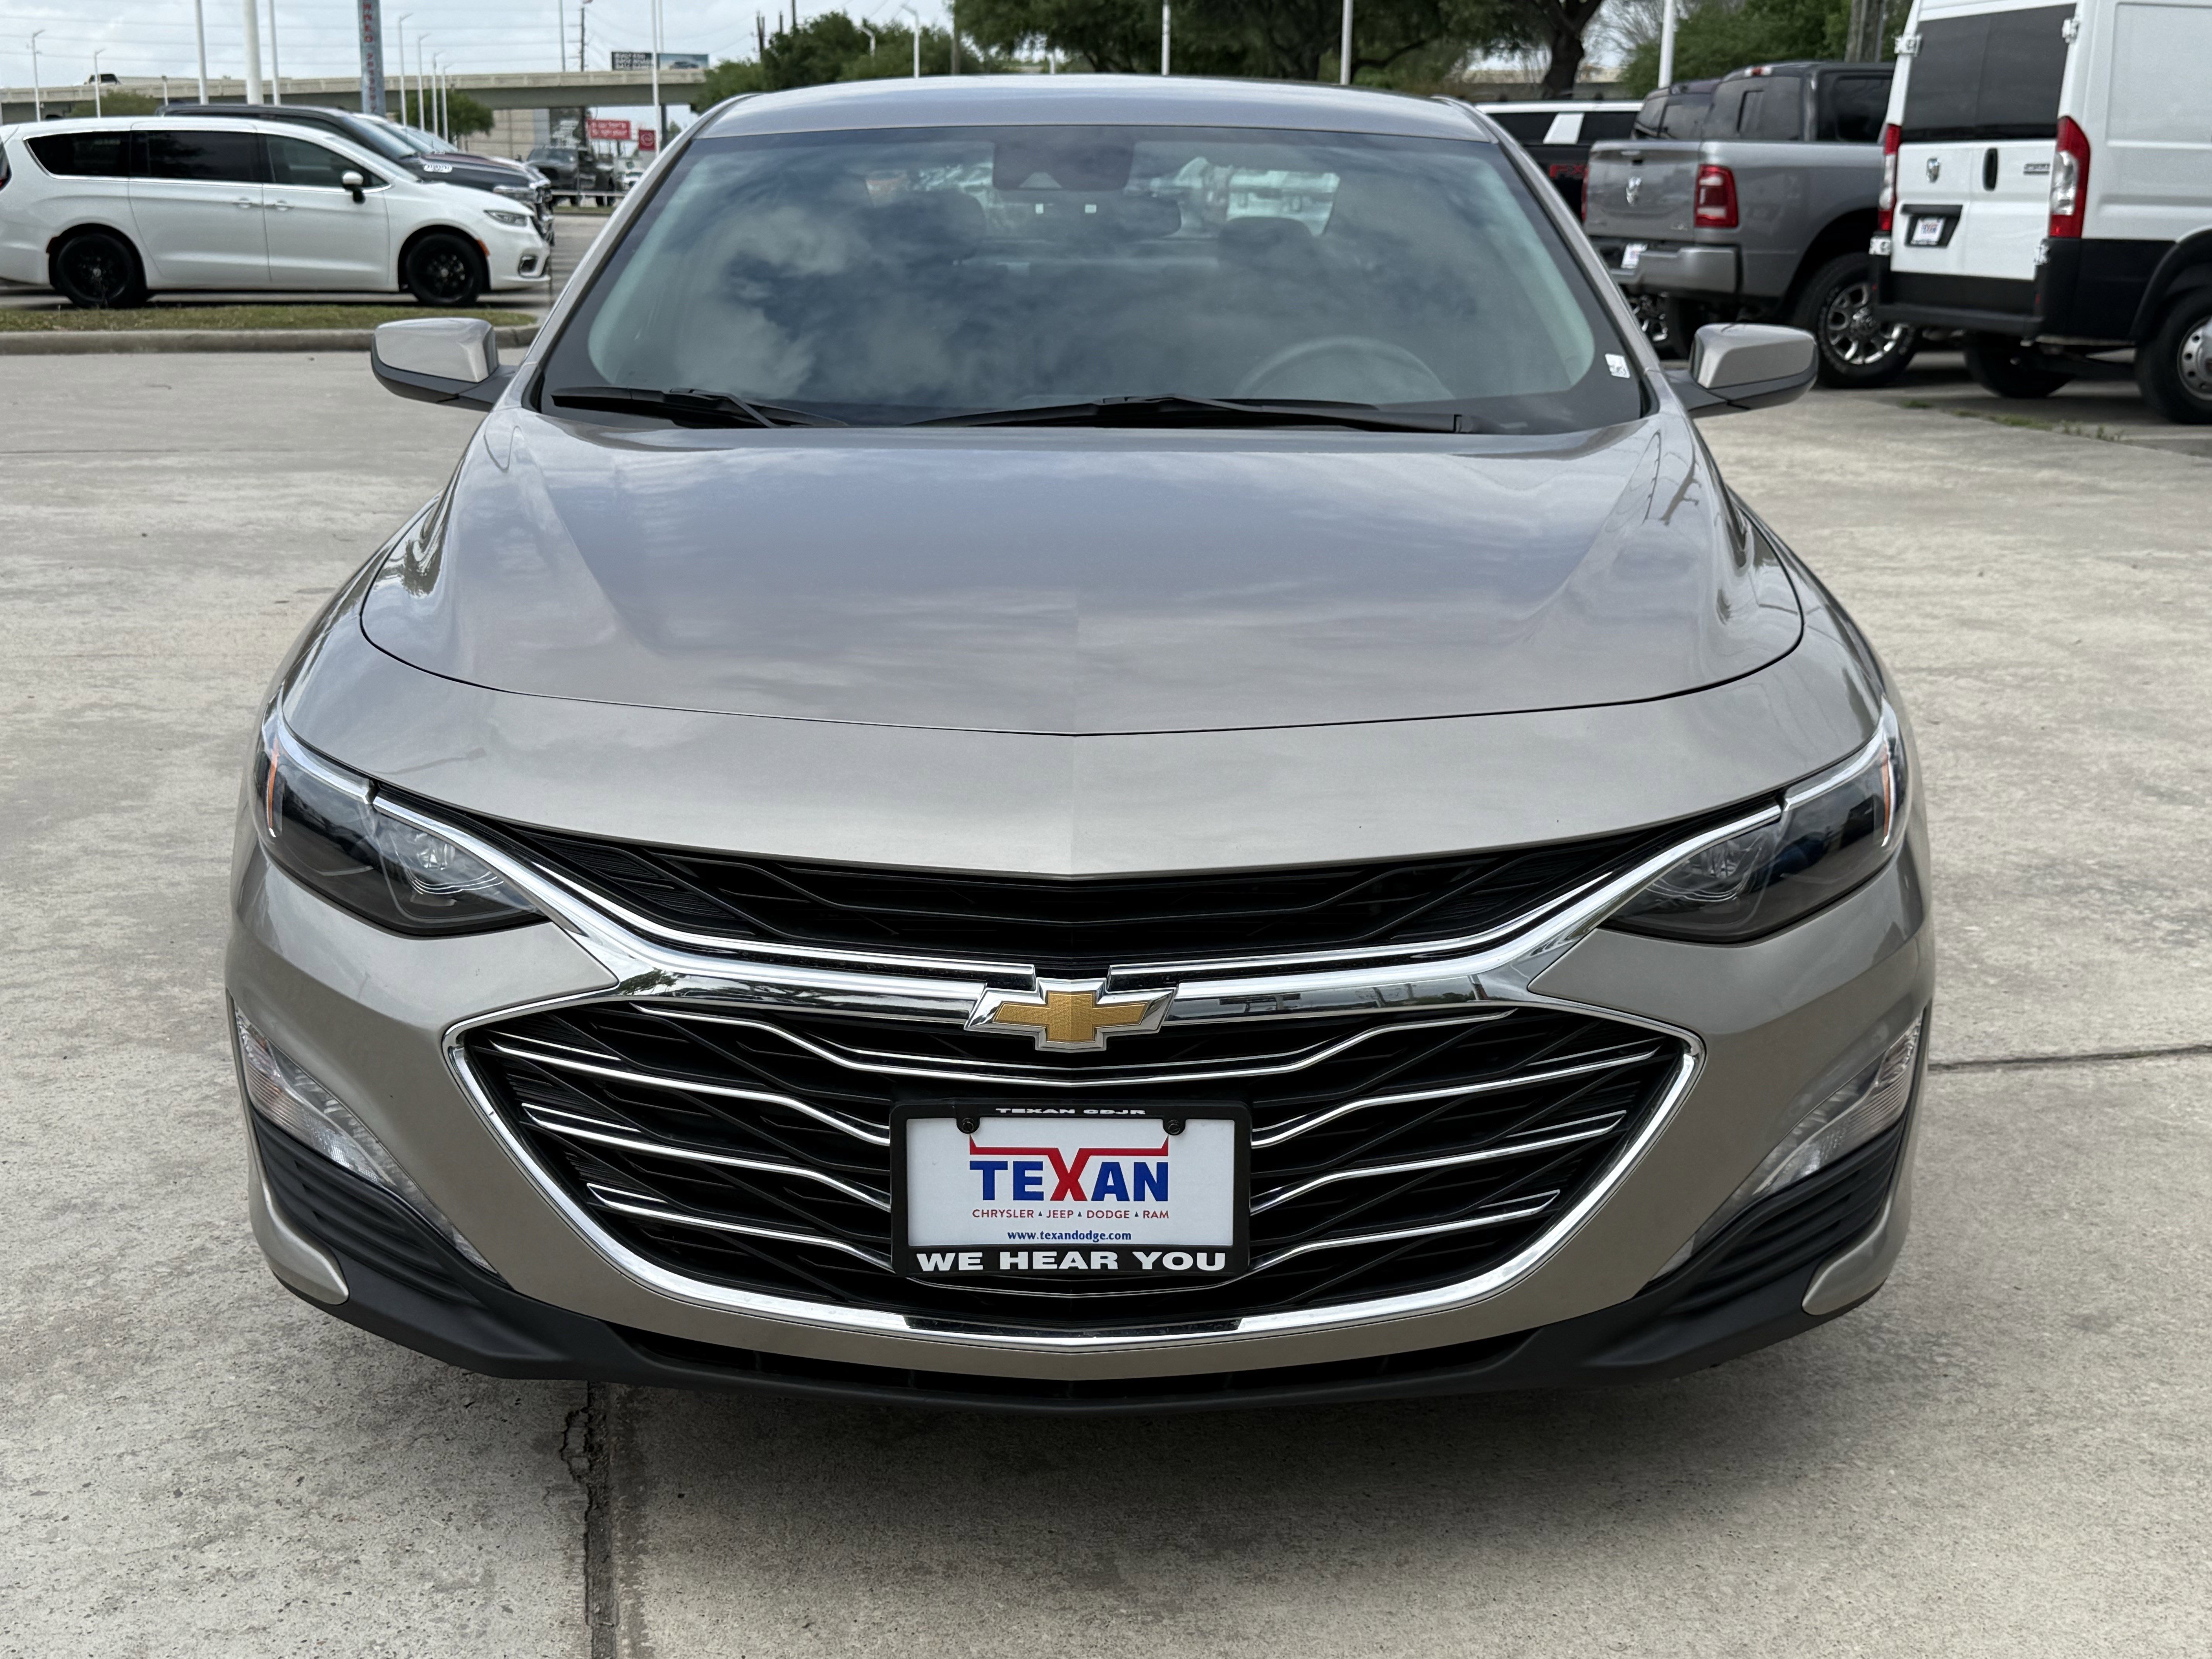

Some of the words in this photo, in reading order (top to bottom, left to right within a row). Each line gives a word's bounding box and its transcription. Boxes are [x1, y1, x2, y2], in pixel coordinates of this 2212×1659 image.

[969, 1148, 1169, 1202] TEXAN
[972, 1209, 1034, 1218] CHRYSLER
[1046, 1209, 1074, 1219] JEEP
[1087, 1210, 1130, 1219] DODGE
[1143, 1210, 1169, 1219] RAM
[1007, 1230, 1132, 1243] www.texandodge.com
[916, 1252, 983, 1271] WE
[1000, 1251, 1118, 1270] HEAR
[1132, 1251, 1225, 1271] YOU
